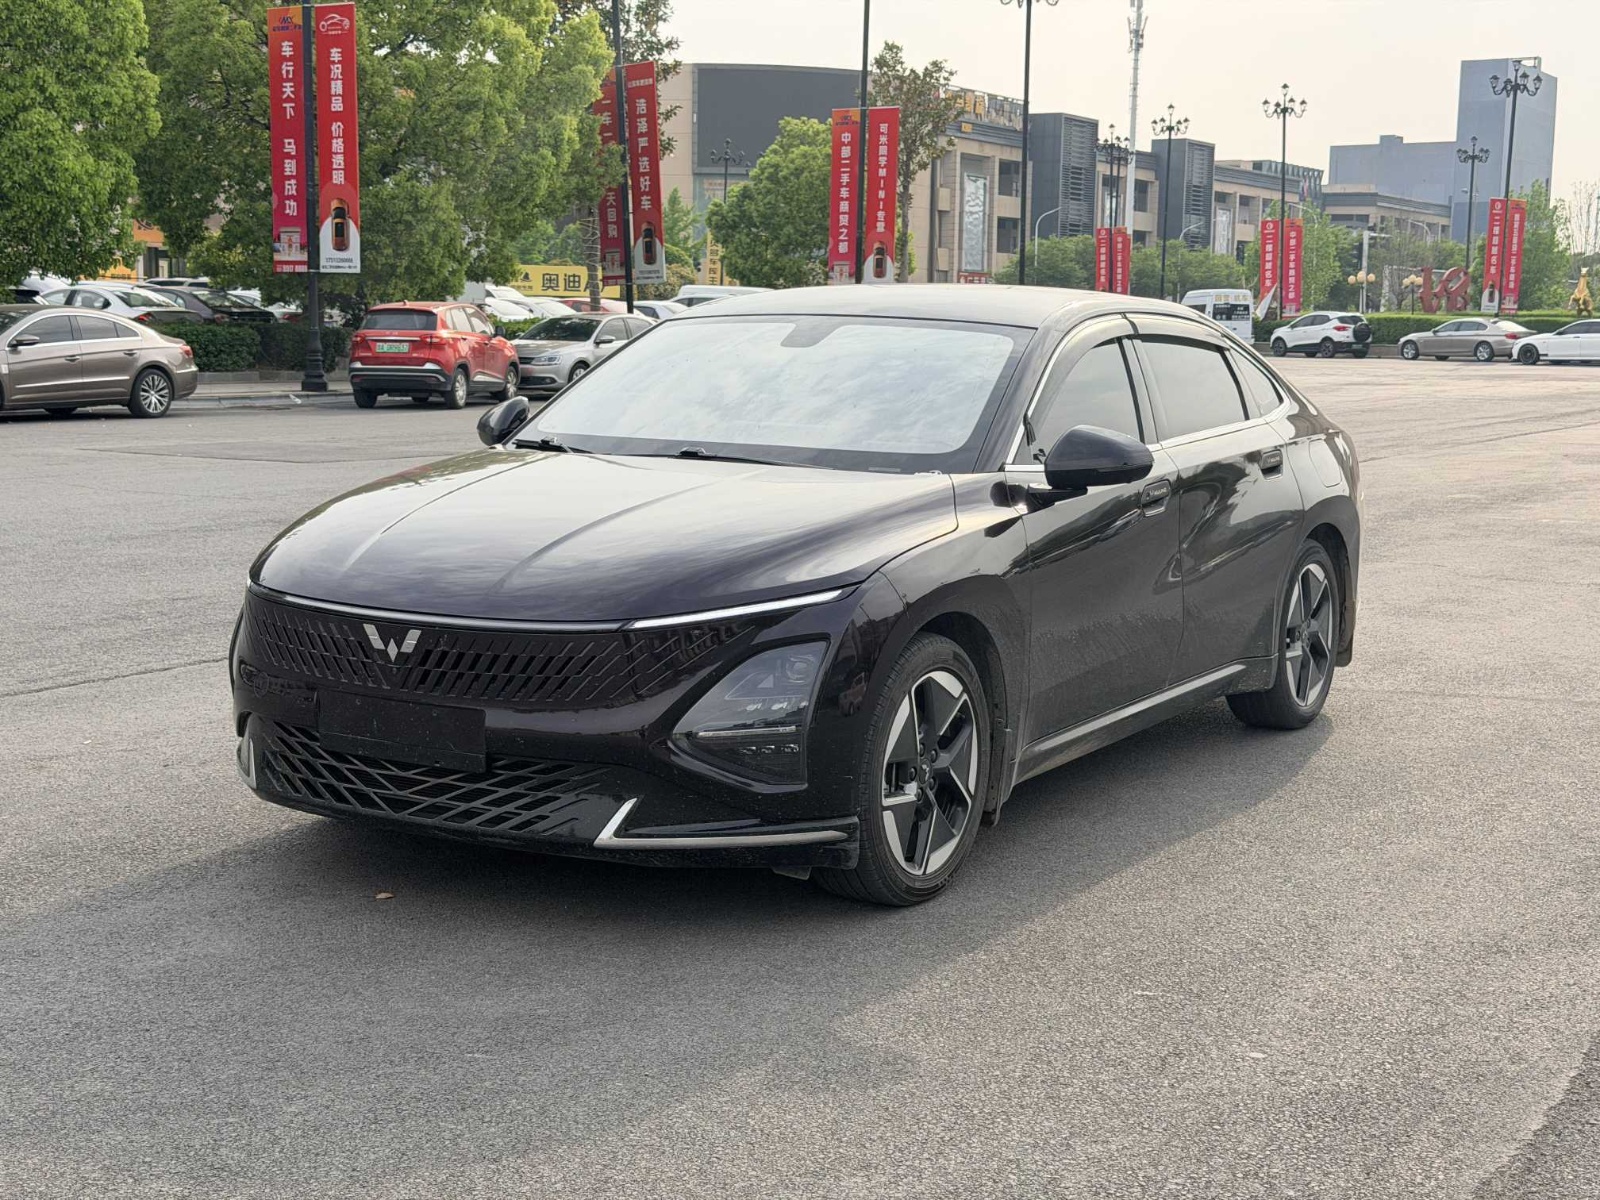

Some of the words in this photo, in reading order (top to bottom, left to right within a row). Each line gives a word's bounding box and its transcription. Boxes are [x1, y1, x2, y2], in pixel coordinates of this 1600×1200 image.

[281, 40, 296, 120] 车行天下
[329, 47, 344, 112] 车况精品
[283, 138, 298, 216] 马到成功
[331, 121, 345, 185] 价格透明
[635, 98, 652, 211] 浩泽严选好车
[838, 131, 852, 254] 中部二手车商贸之都
